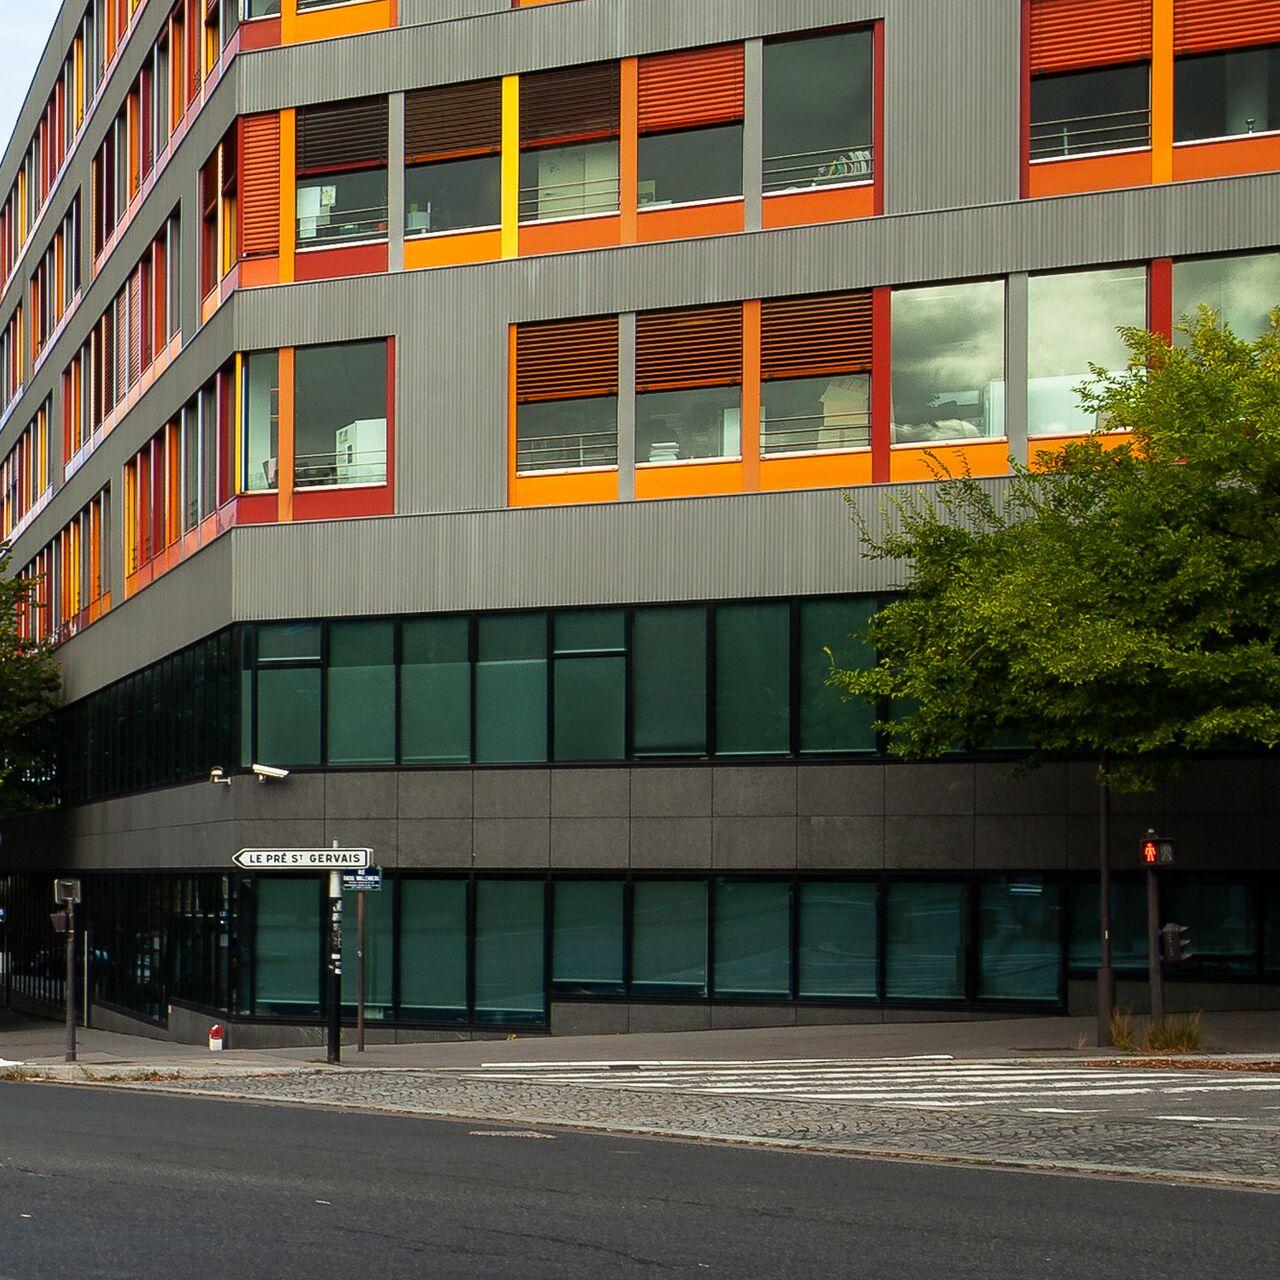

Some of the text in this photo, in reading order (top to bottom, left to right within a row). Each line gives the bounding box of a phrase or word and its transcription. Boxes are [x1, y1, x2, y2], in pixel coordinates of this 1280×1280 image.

[249, 854, 262, 863] LE
[266, 852, 287, 863] PRÉ
[309, 854, 360, 863] GERVAIS
